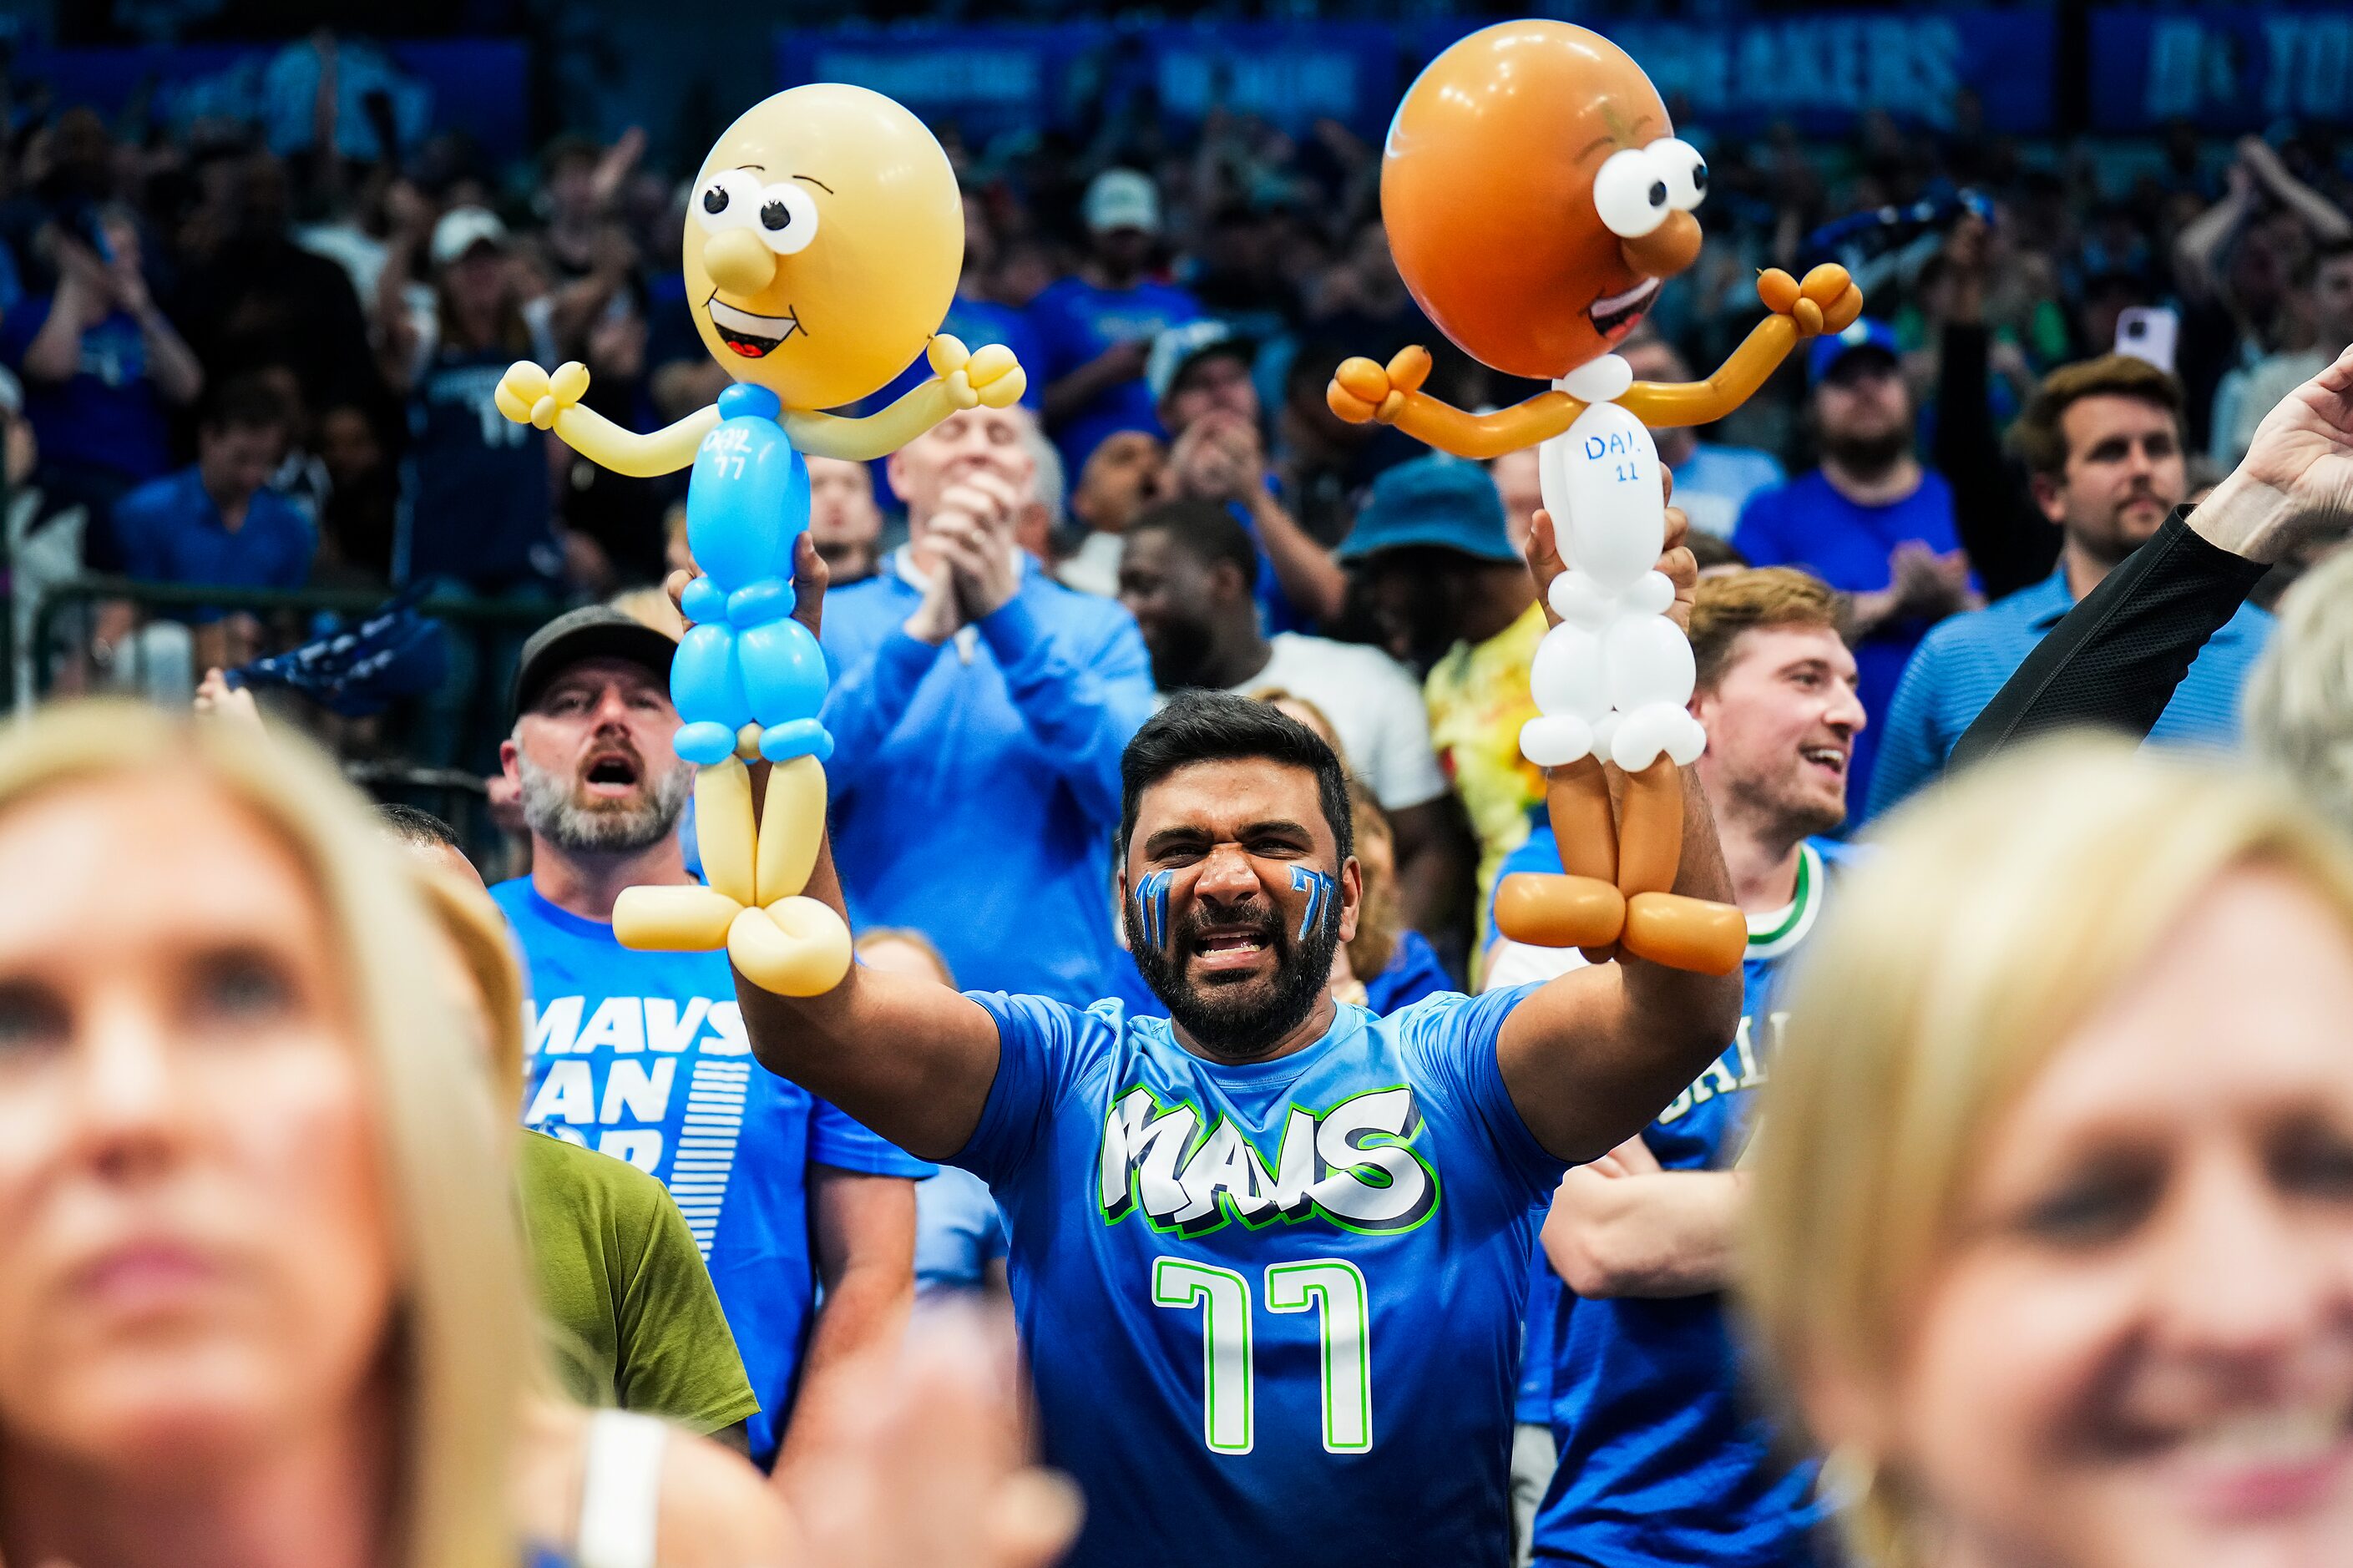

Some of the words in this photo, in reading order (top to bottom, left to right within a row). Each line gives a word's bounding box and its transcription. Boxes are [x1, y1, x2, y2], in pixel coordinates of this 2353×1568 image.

[714, 456, 746, 480] 77
[1616, 462, 1638, 482] 11
[521, 994, 752, 1057] MAVS
[522, 1056, 678, 1125] AN
[1100, 1082, 1441, 1241] MAVS
[1152, 1255, 1374, 1455] 77
